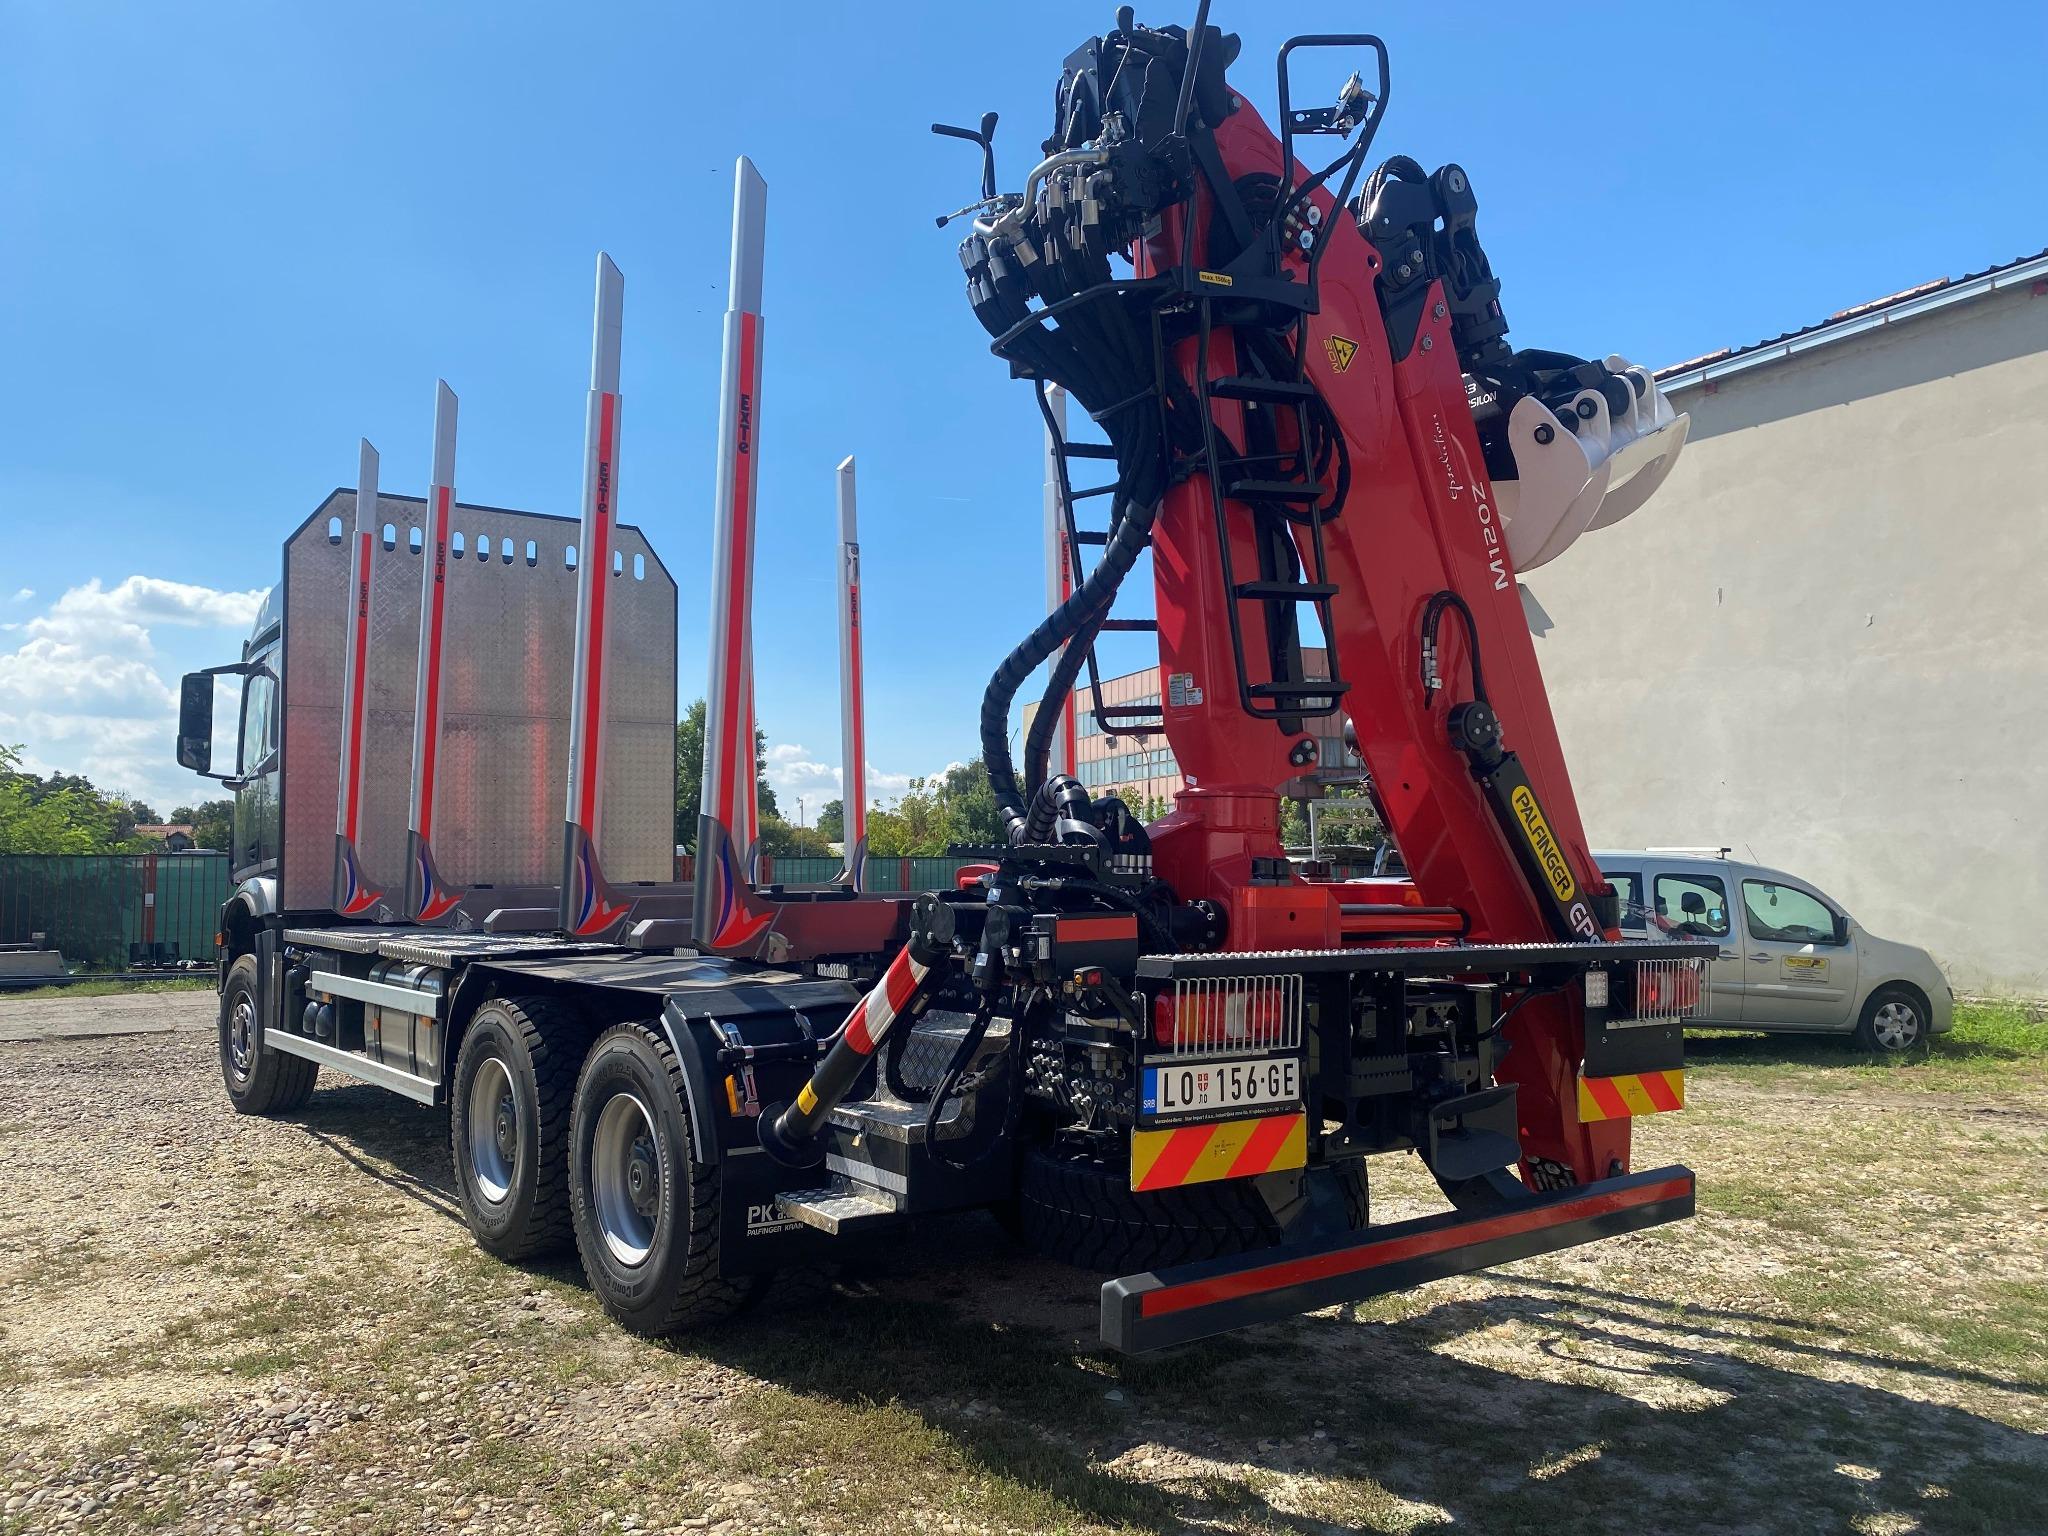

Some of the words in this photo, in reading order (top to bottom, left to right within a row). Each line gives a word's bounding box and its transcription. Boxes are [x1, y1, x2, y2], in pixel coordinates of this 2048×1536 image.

[1468, 391, 1497, 408] SILON
[1515, 791, 1571, 896] PALFINGER
[1163, 1071, 1194, 1108] LO
[1143, 1099, 1156, 1109] SRB
[748, 1204, 774, 1224] PK
[746, 1225, 782, 1236] PALFINGER
